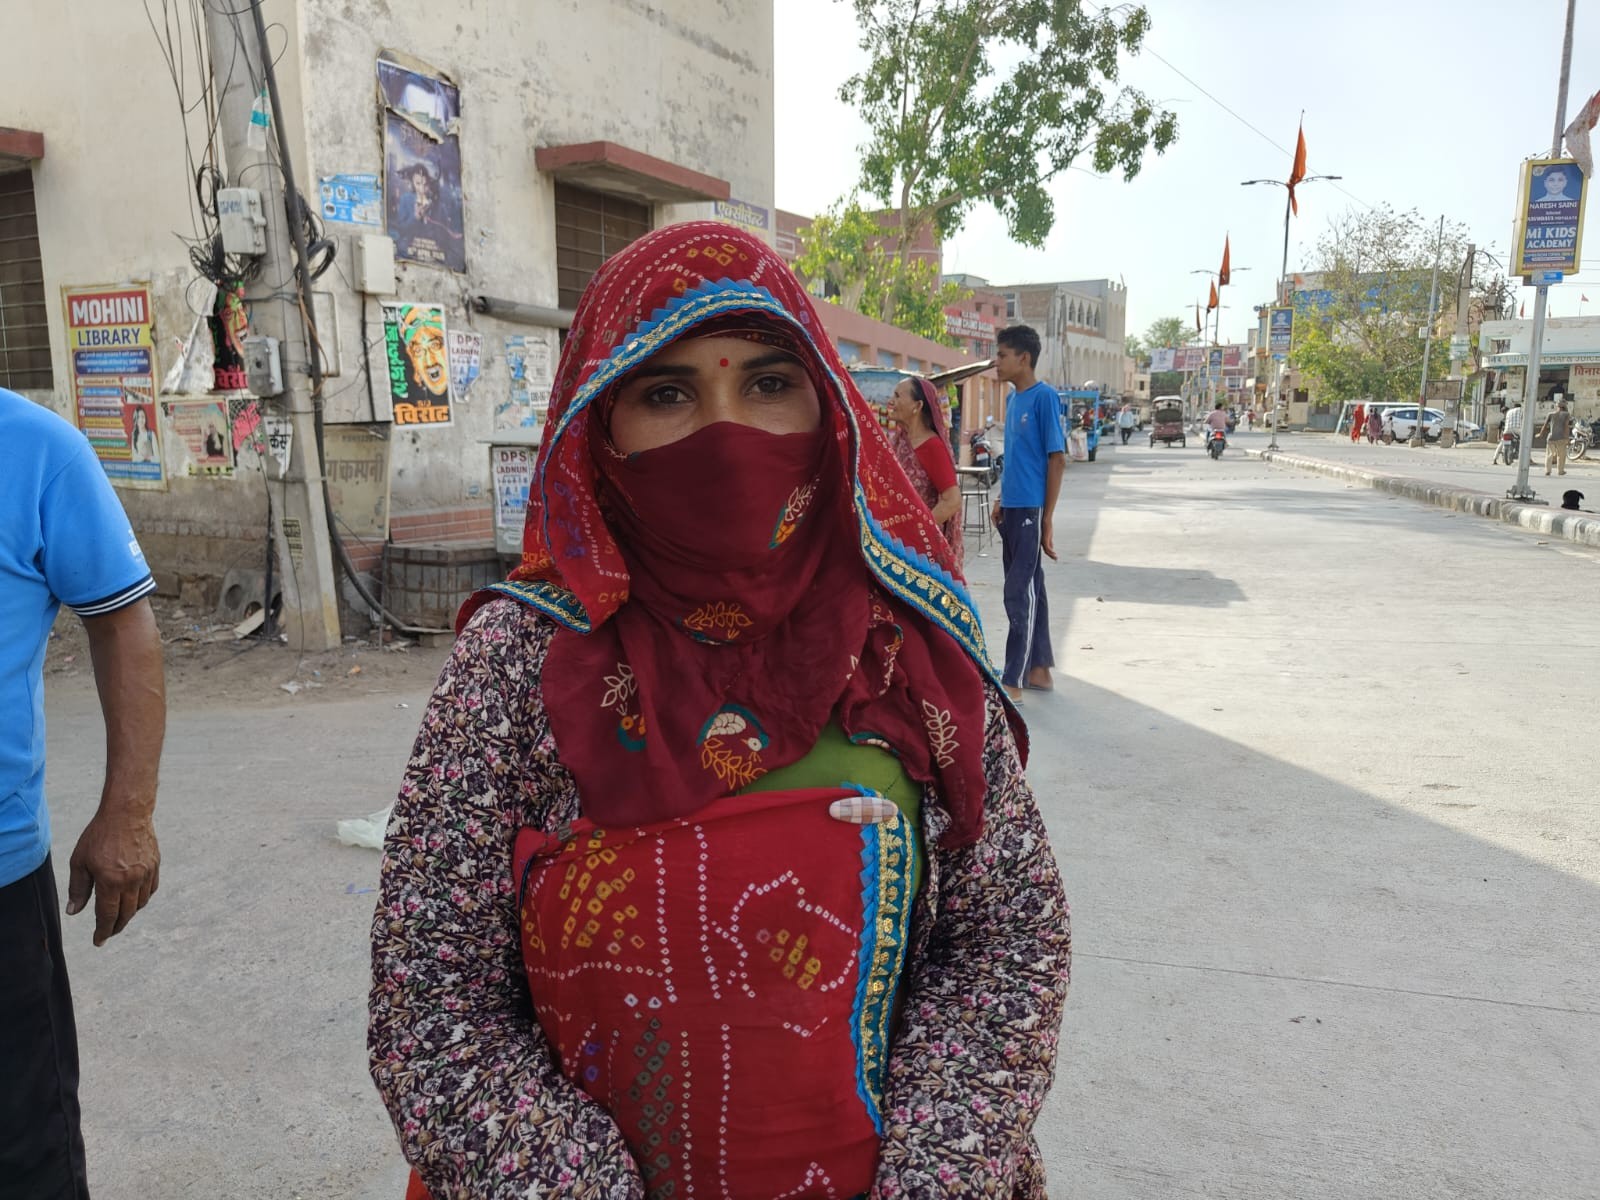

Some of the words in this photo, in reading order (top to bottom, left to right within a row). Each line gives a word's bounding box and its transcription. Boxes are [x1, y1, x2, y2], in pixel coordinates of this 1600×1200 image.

[1545, 227, 1577, 238] KIDS
[1526, 239, 1574, 249] ACADEMY
[72, 296, 144, 325] MOHINI
[78, 327, 140, 346] LIBRARY
[457, 335, 480, 346] DPS
[394, 403, 449, 425] विराट
[500, 450, 527, 462] DPS
[496, 465, 528, 474] LADNUN
